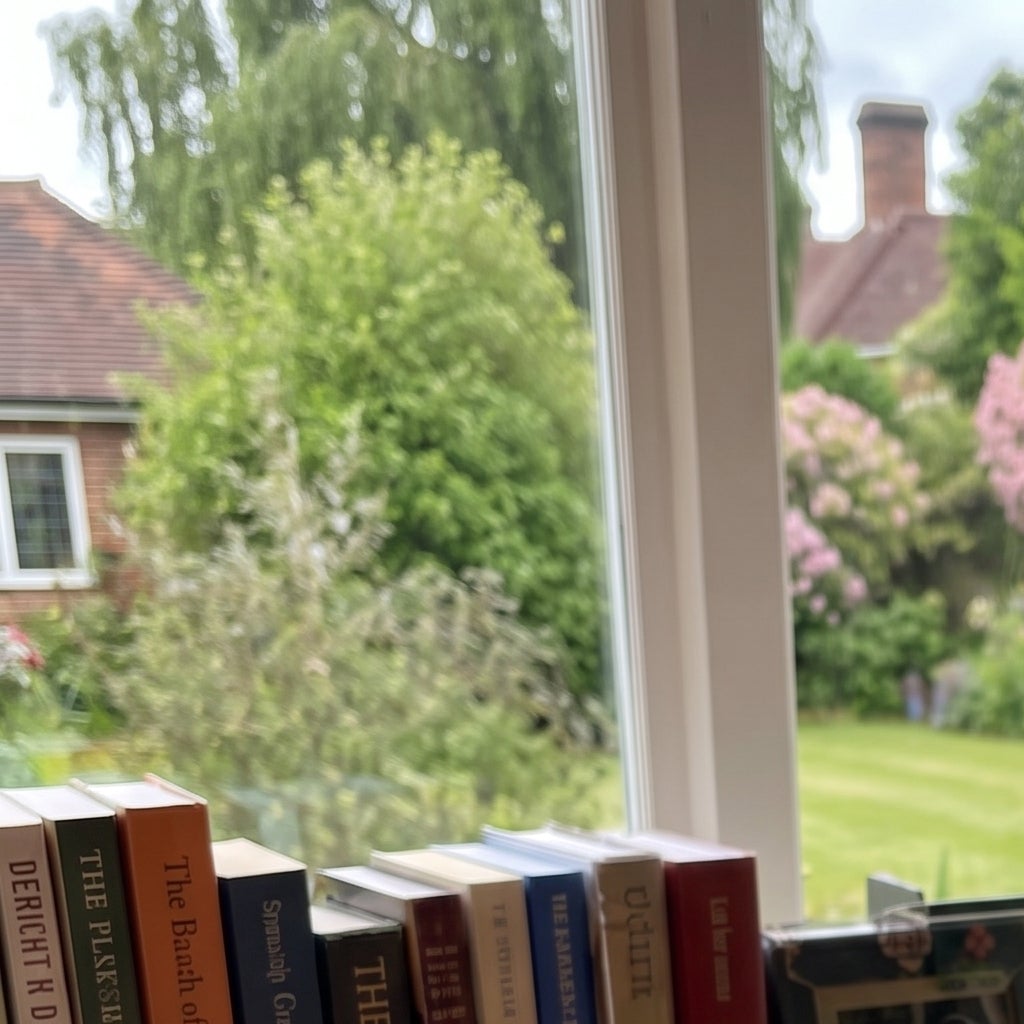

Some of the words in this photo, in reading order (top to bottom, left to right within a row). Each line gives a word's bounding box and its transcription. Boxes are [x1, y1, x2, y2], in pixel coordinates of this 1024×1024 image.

[80, 849, 109, 910] THE
[164, 855, 192, 909] The
[9, 860, 52, 969] DERICHT
